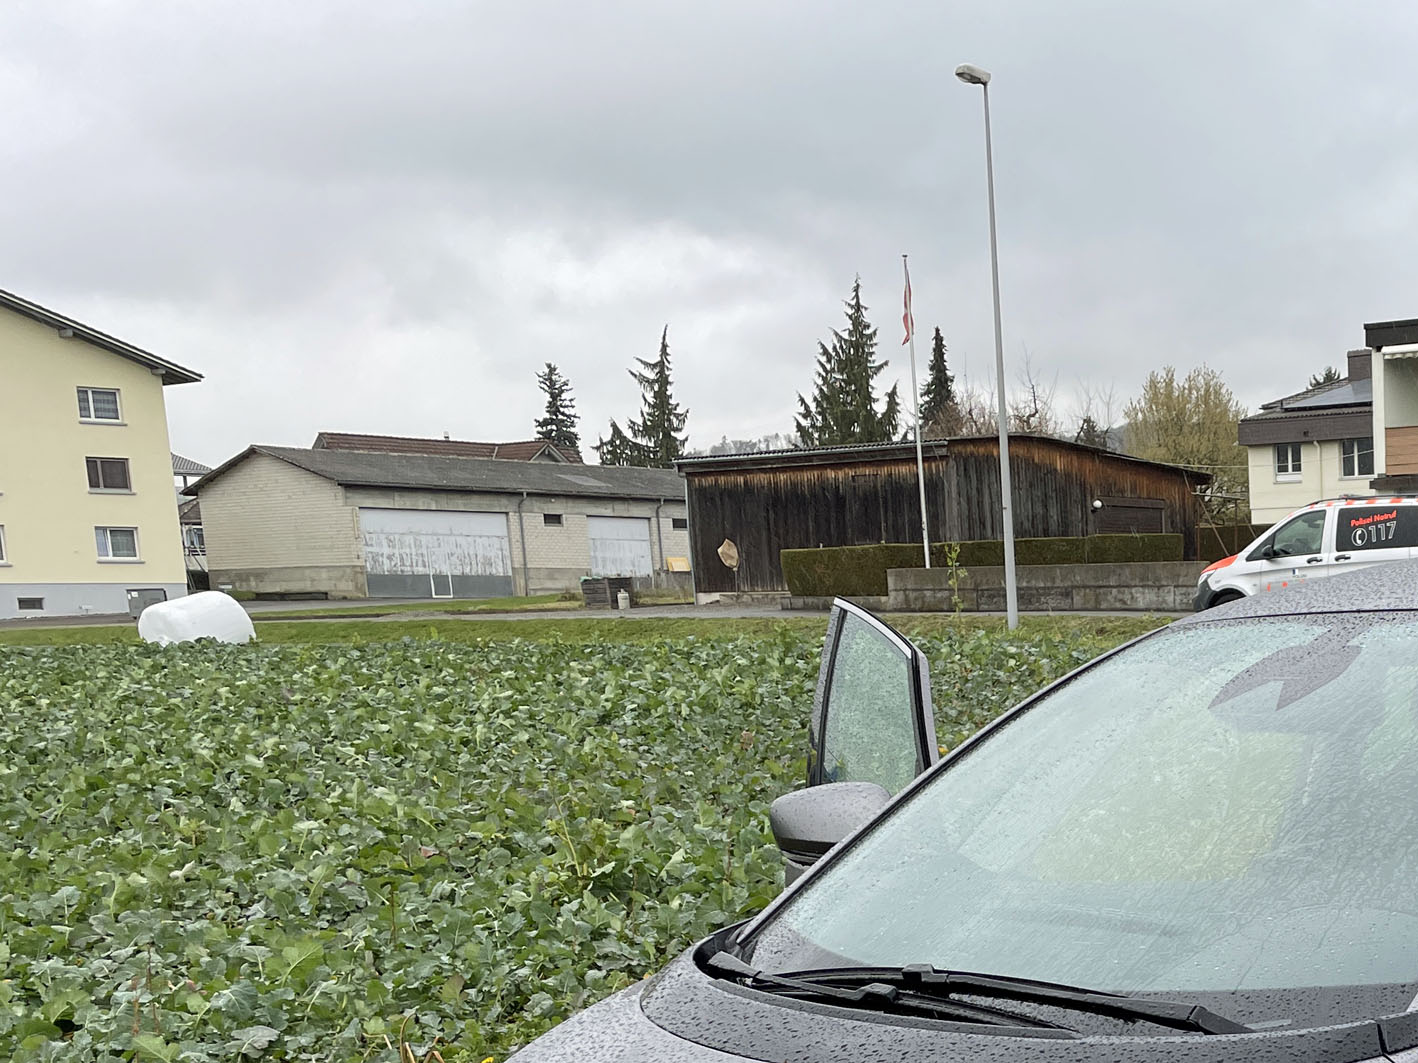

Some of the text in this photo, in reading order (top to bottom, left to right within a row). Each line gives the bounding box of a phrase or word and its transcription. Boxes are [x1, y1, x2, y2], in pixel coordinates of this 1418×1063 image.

[1350, 509, 1397, 527] Polizei Notruf
[1368, 521, 1397, 542] 117
